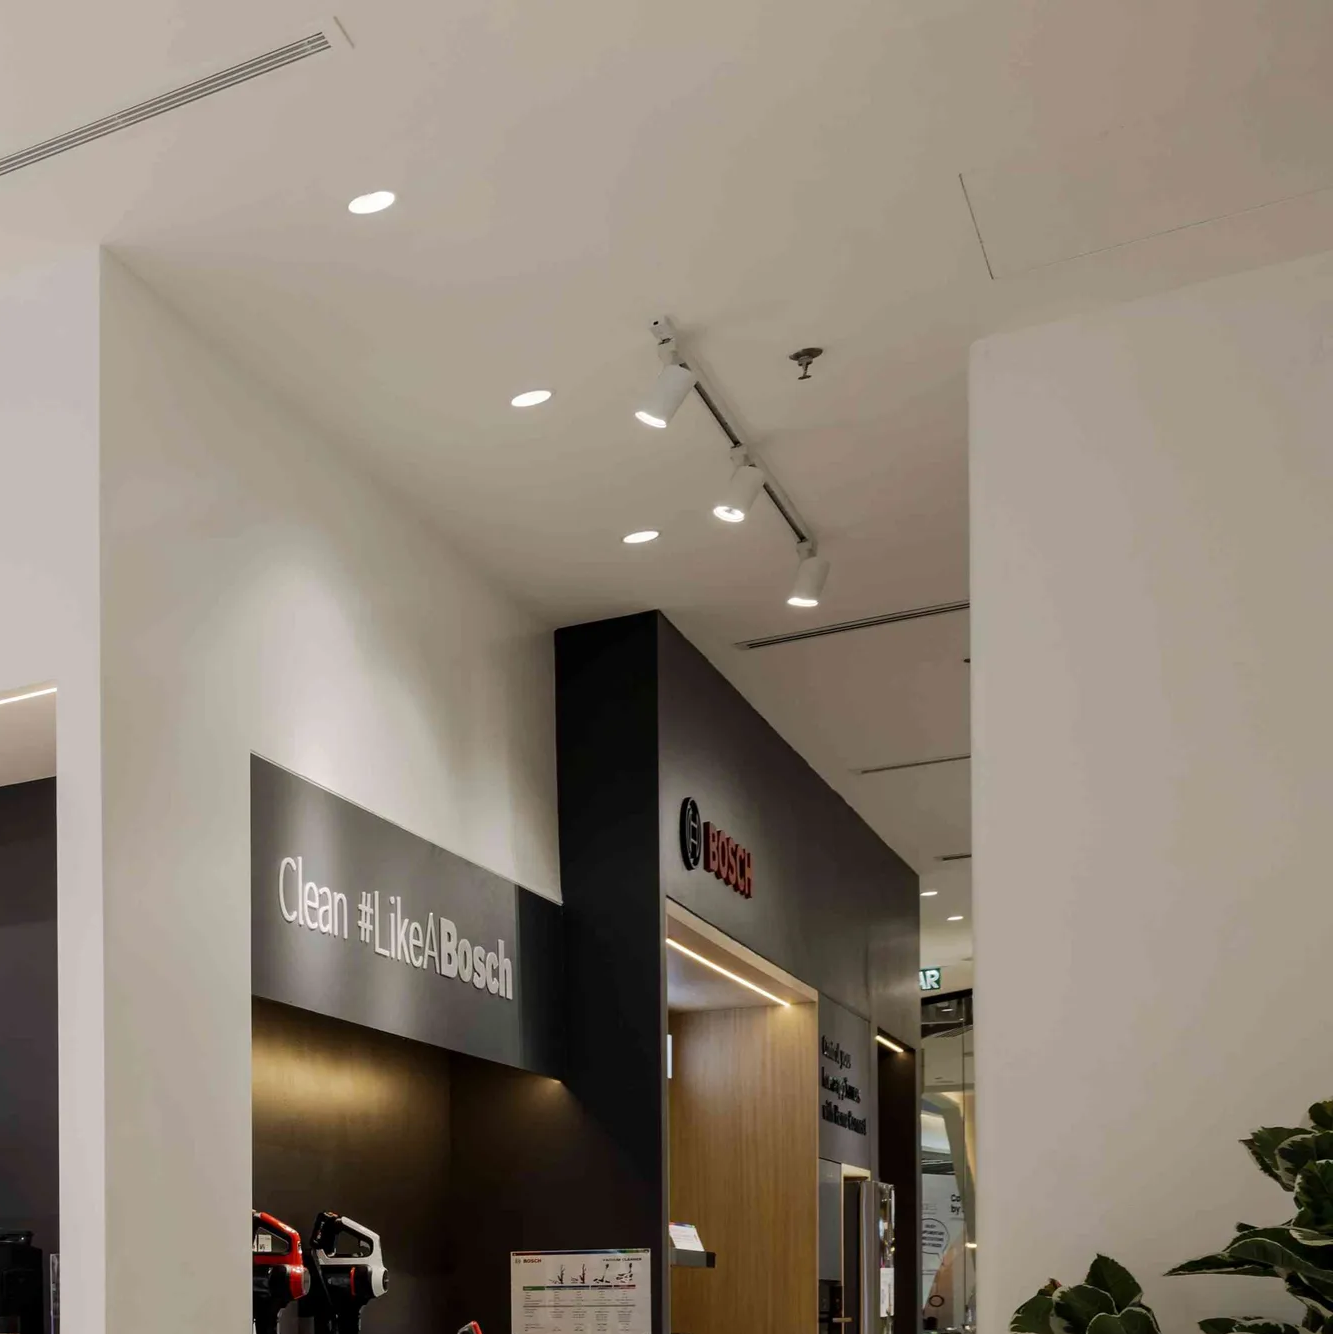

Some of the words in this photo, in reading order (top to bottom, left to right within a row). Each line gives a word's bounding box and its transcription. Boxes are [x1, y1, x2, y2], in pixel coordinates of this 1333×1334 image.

[703, 821, 753, 899] BOSCH
[279, 856, 348, 939] Clean
[357, 890, 513, 1001] #LikeABosch
[523, 1258, 542, 1267] BOSCH
